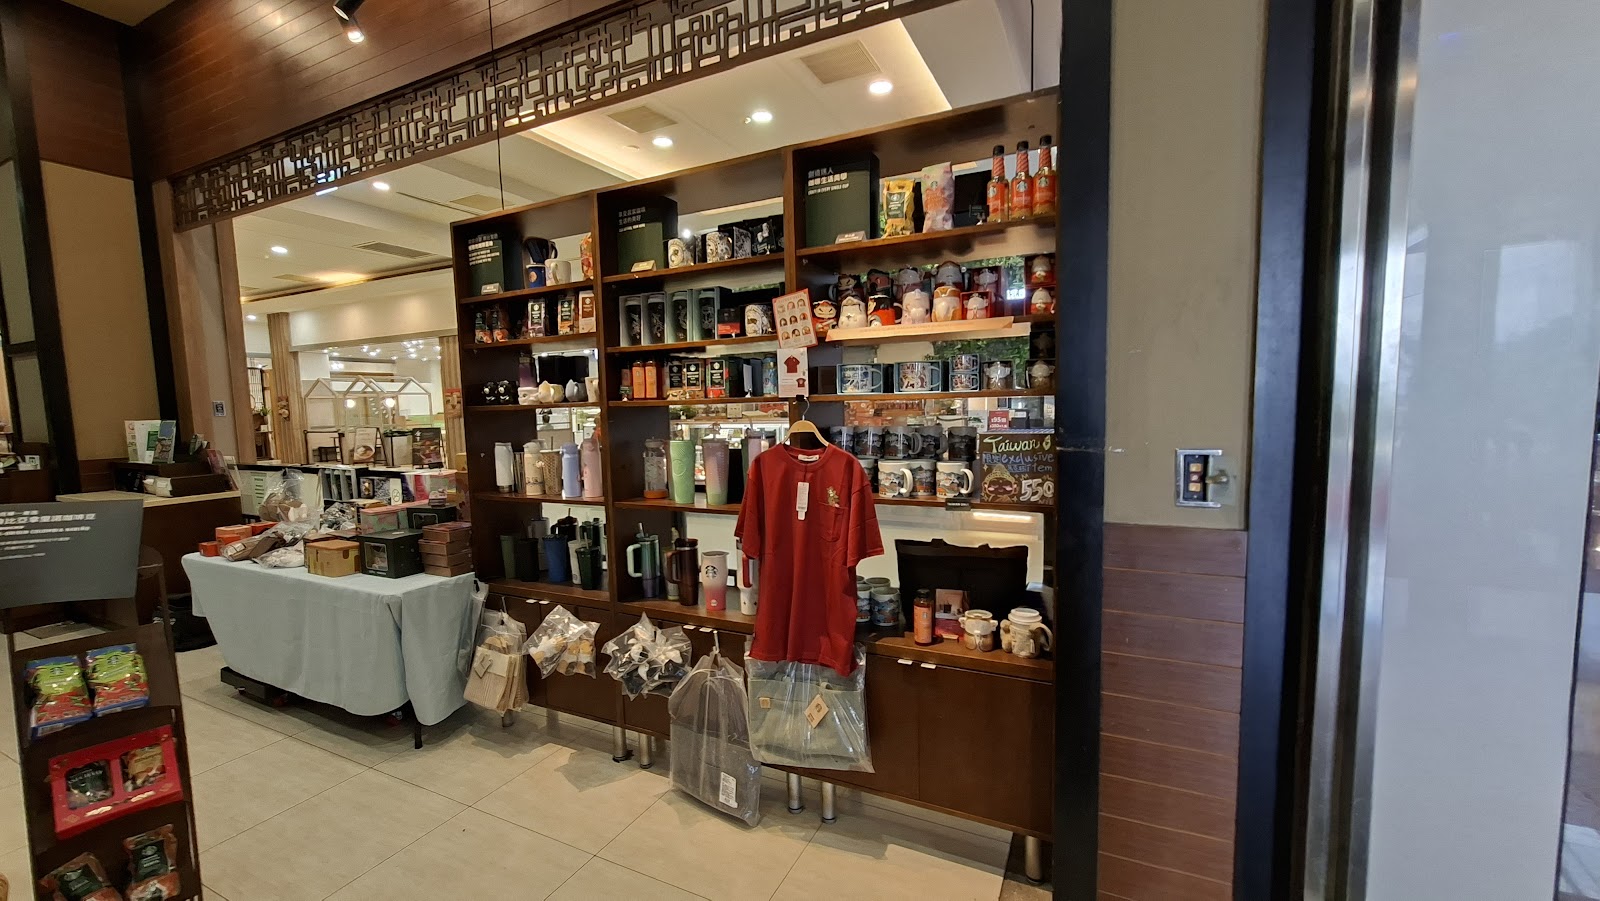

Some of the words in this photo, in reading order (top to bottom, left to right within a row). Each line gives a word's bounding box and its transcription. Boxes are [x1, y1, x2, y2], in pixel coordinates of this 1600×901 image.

[983, 435, 1041, 453] Taiwan
[1002, 451, 1055, 464] exclusive
[1027, 462, 1053, 473] item
[1020, 478, 1055, 502] 550
